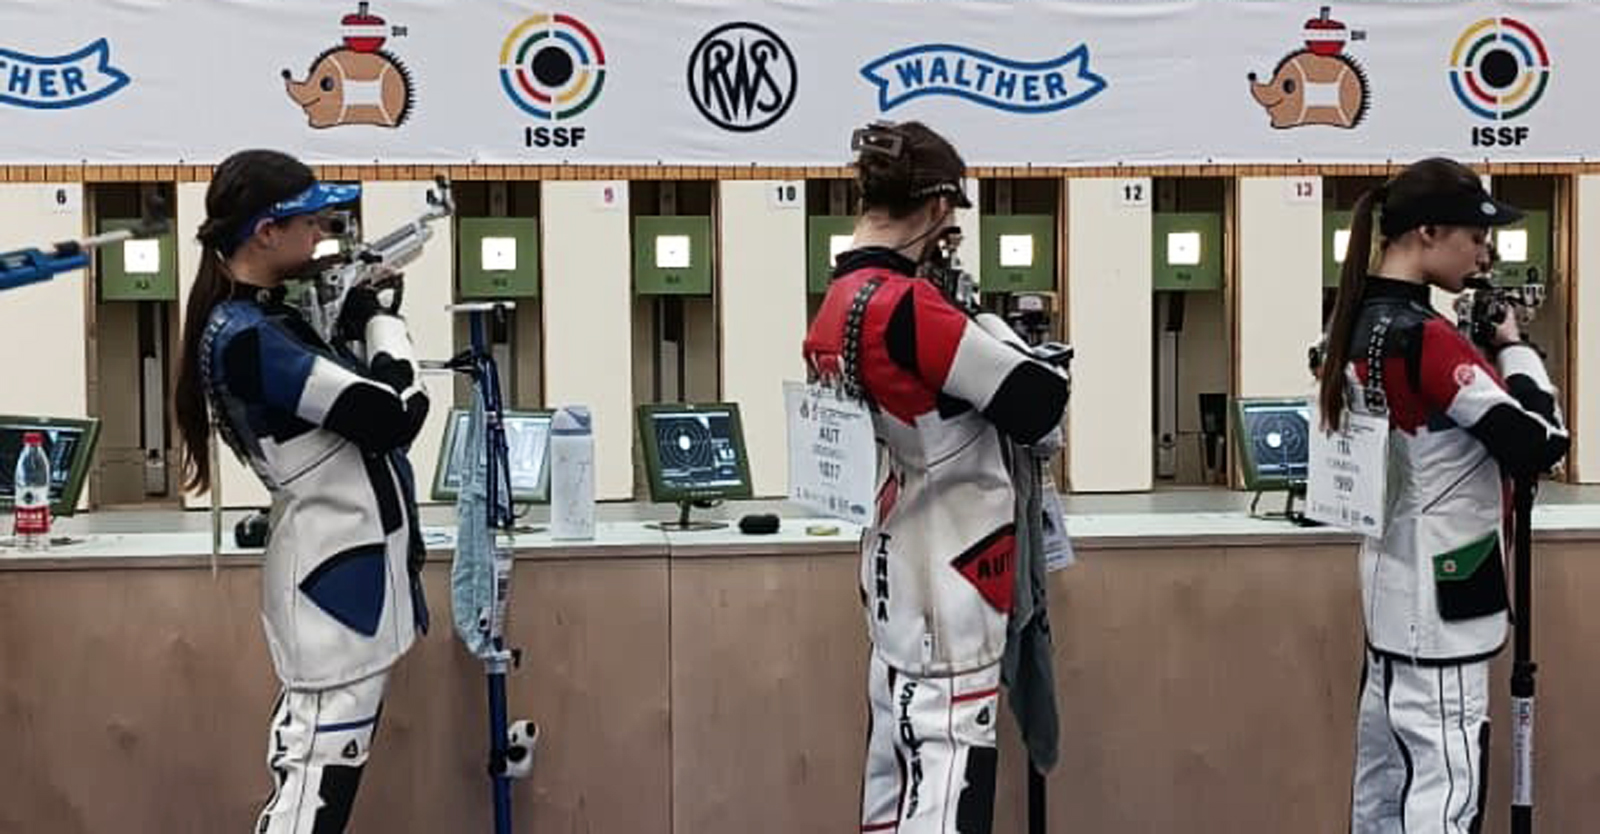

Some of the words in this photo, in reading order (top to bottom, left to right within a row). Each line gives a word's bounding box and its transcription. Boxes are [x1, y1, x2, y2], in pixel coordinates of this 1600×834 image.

[0, 61, 87, 97] HER
[702, 36, 783, 122] RWS
[895, 56, 1067, 102] WALTHER
[525, 126, 586, 148] ISSF
[1472, 126, 1530, 147] ISSF
[56, 188, 67, 205] 6
[776, 185, 796, 202] 10
[1125, 184, 1143, 201] 12
[1296, 181, 1313, 198] 13
[819, 427, 841, 444] AUT
